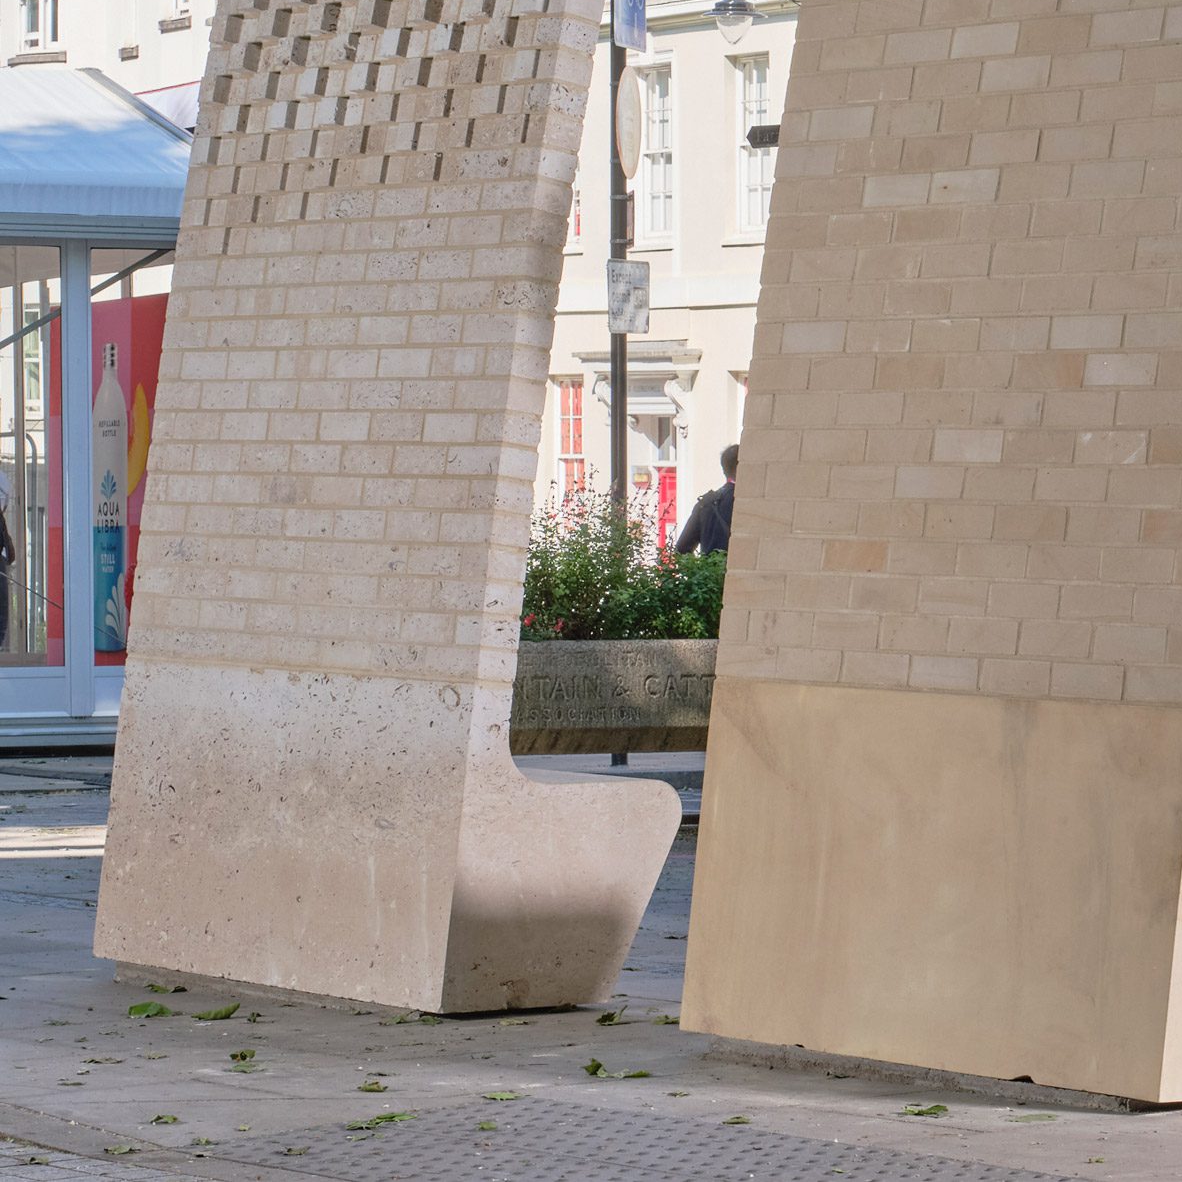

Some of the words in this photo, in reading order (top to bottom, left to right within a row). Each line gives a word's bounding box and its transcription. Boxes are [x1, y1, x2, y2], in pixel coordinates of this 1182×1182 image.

[102, 429, 116, 438] BOTTLE
[97, 501, 120, 517] AQUA
[97, 519, 120, 534] LIBRA
[100, 553, 116, 565] STILL
[613, 676, 630, 698] &
[515, 706, 641, 722] ASSOCIATION
